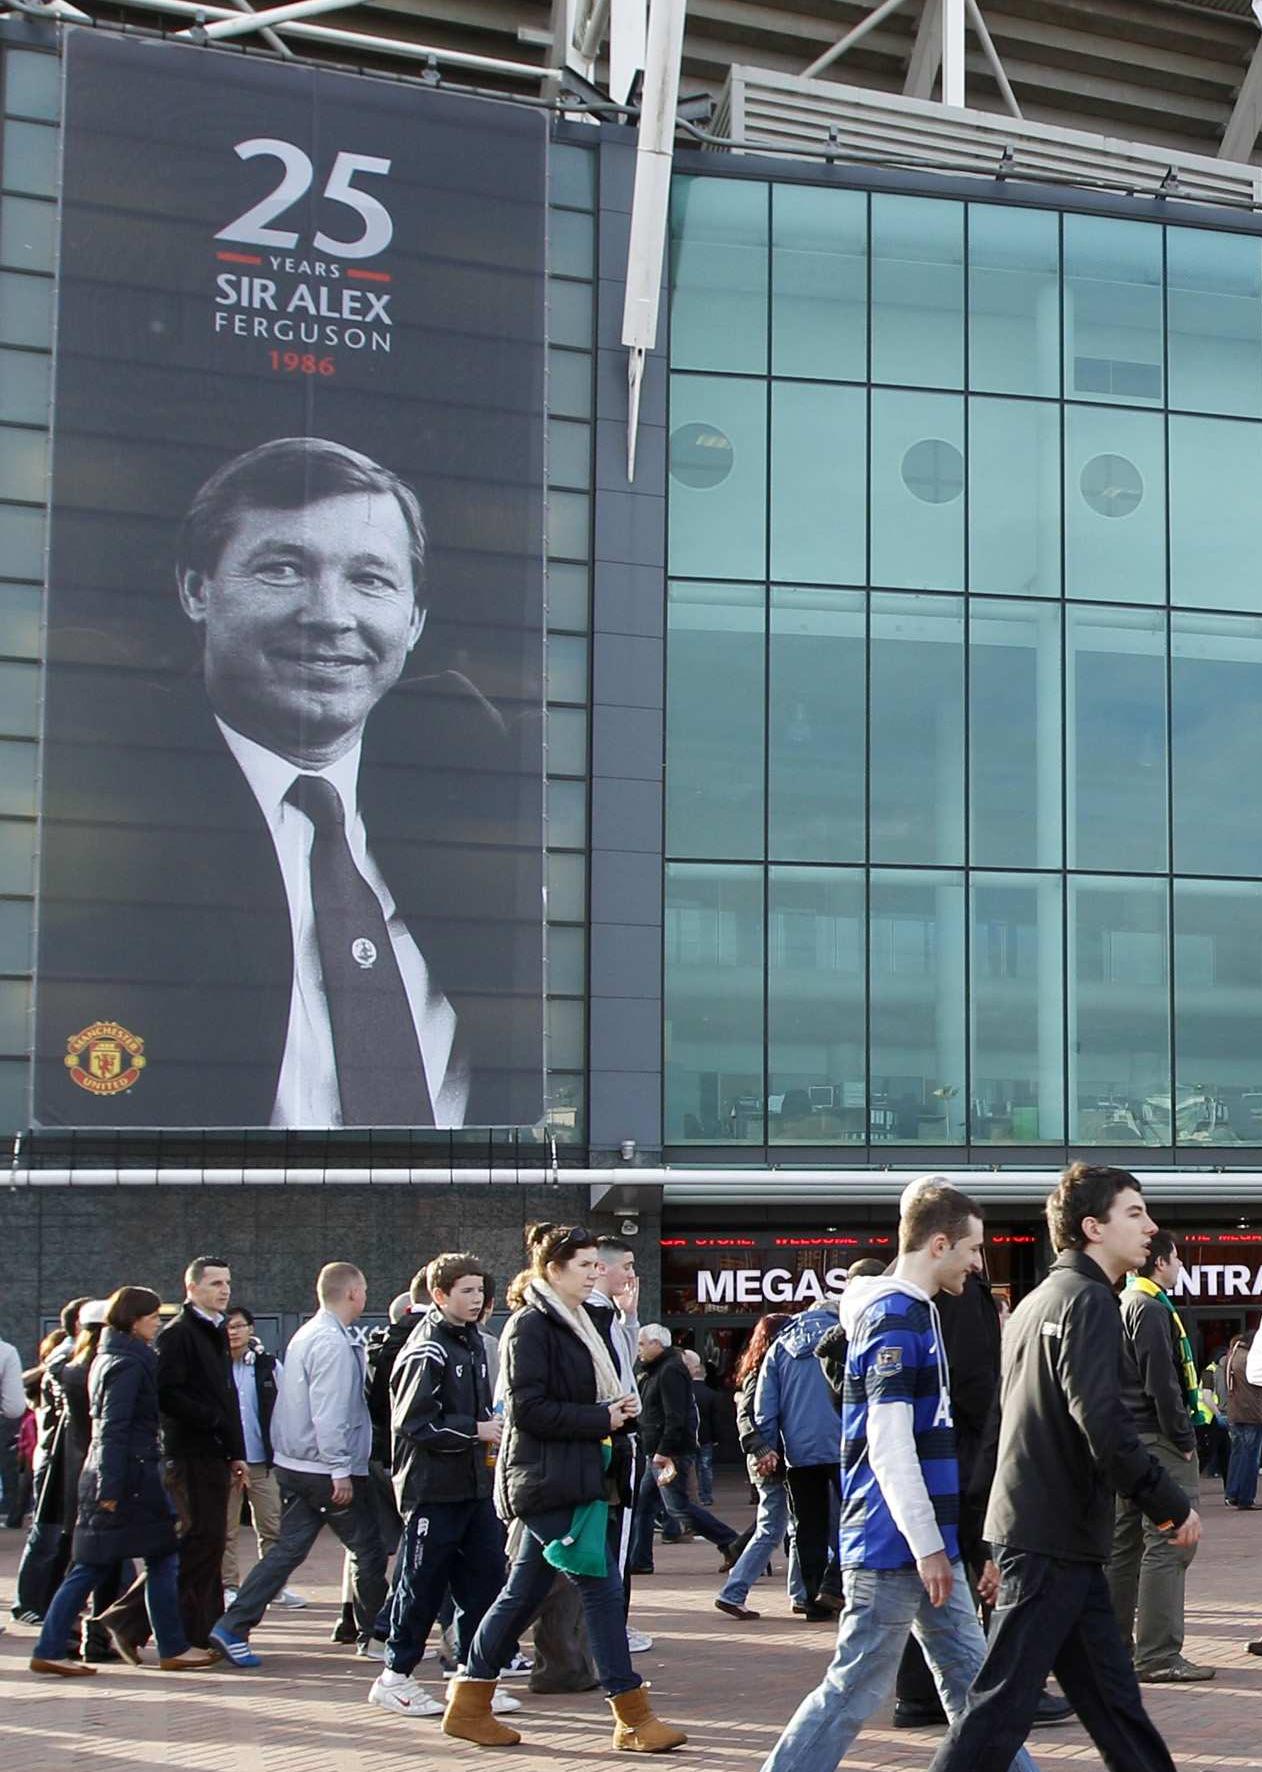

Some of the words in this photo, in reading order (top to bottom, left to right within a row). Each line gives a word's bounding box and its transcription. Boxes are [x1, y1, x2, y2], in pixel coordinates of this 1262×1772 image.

[213, 137, 394, 260] 25
[269, 256, 341, 279] YEARS
[215, 273, 278, 312] SIR
[286, 282, 393, 326] ALEX
[215, 312, 391, 352] FERGUSON
[268, 350, 336, 376] 1986
[82, 1077, 129, 1091] UNITED
